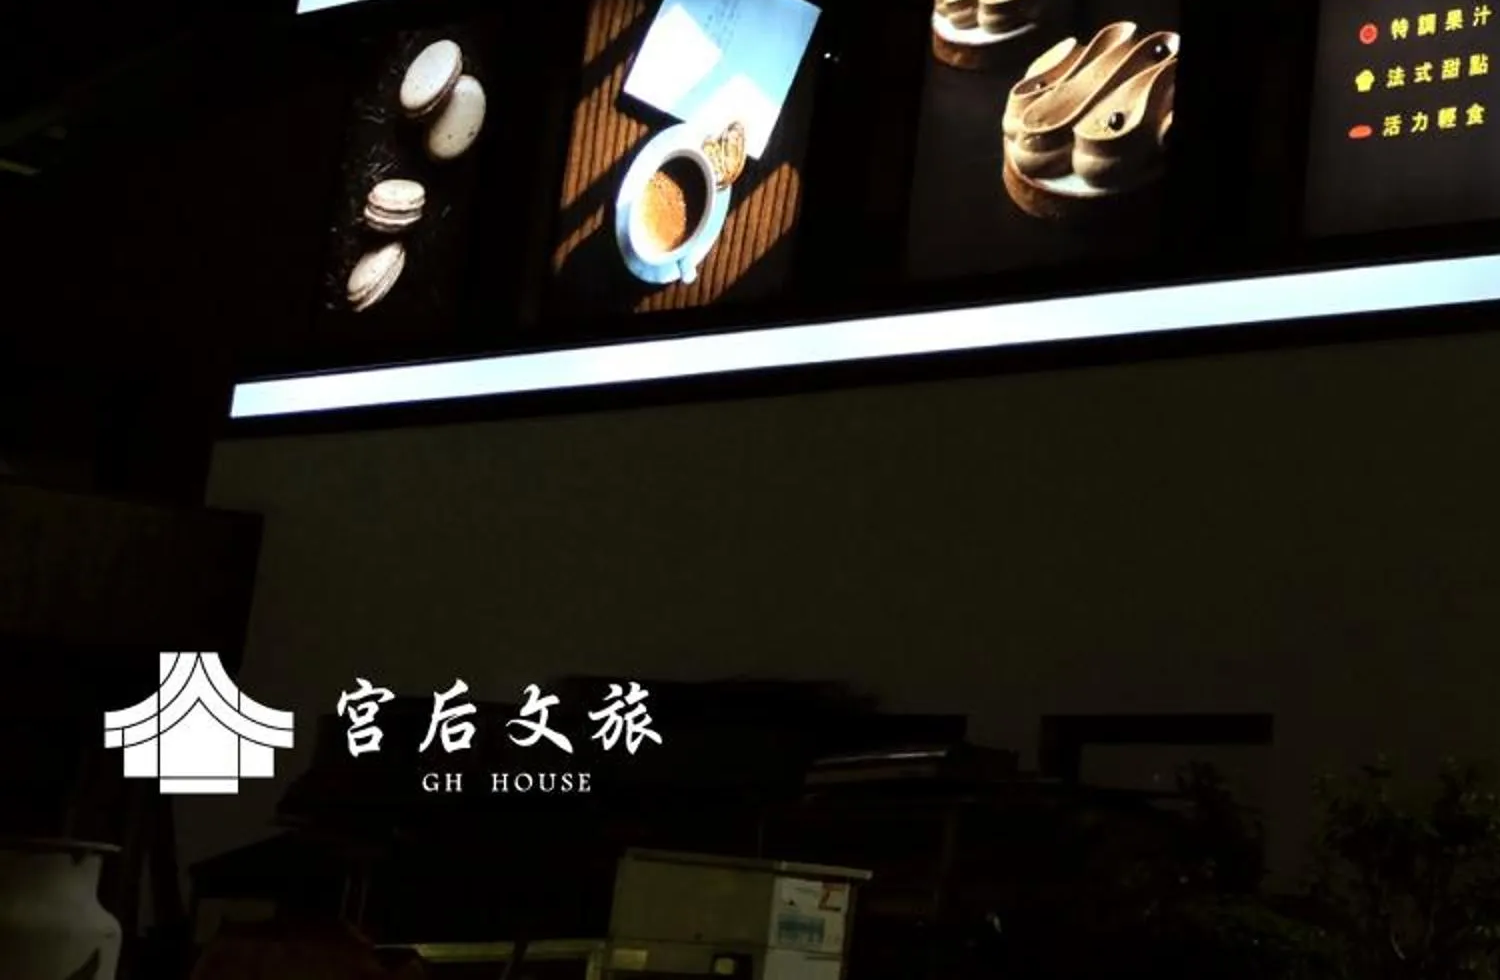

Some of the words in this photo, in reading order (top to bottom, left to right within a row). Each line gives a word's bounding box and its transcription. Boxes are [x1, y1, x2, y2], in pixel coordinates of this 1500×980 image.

[1390, 4, 1493, 41] 特調果汁
[1385, 53, 1489, 89] 法式甜點
[1382, 102, 1486, 137] 活力輕食
